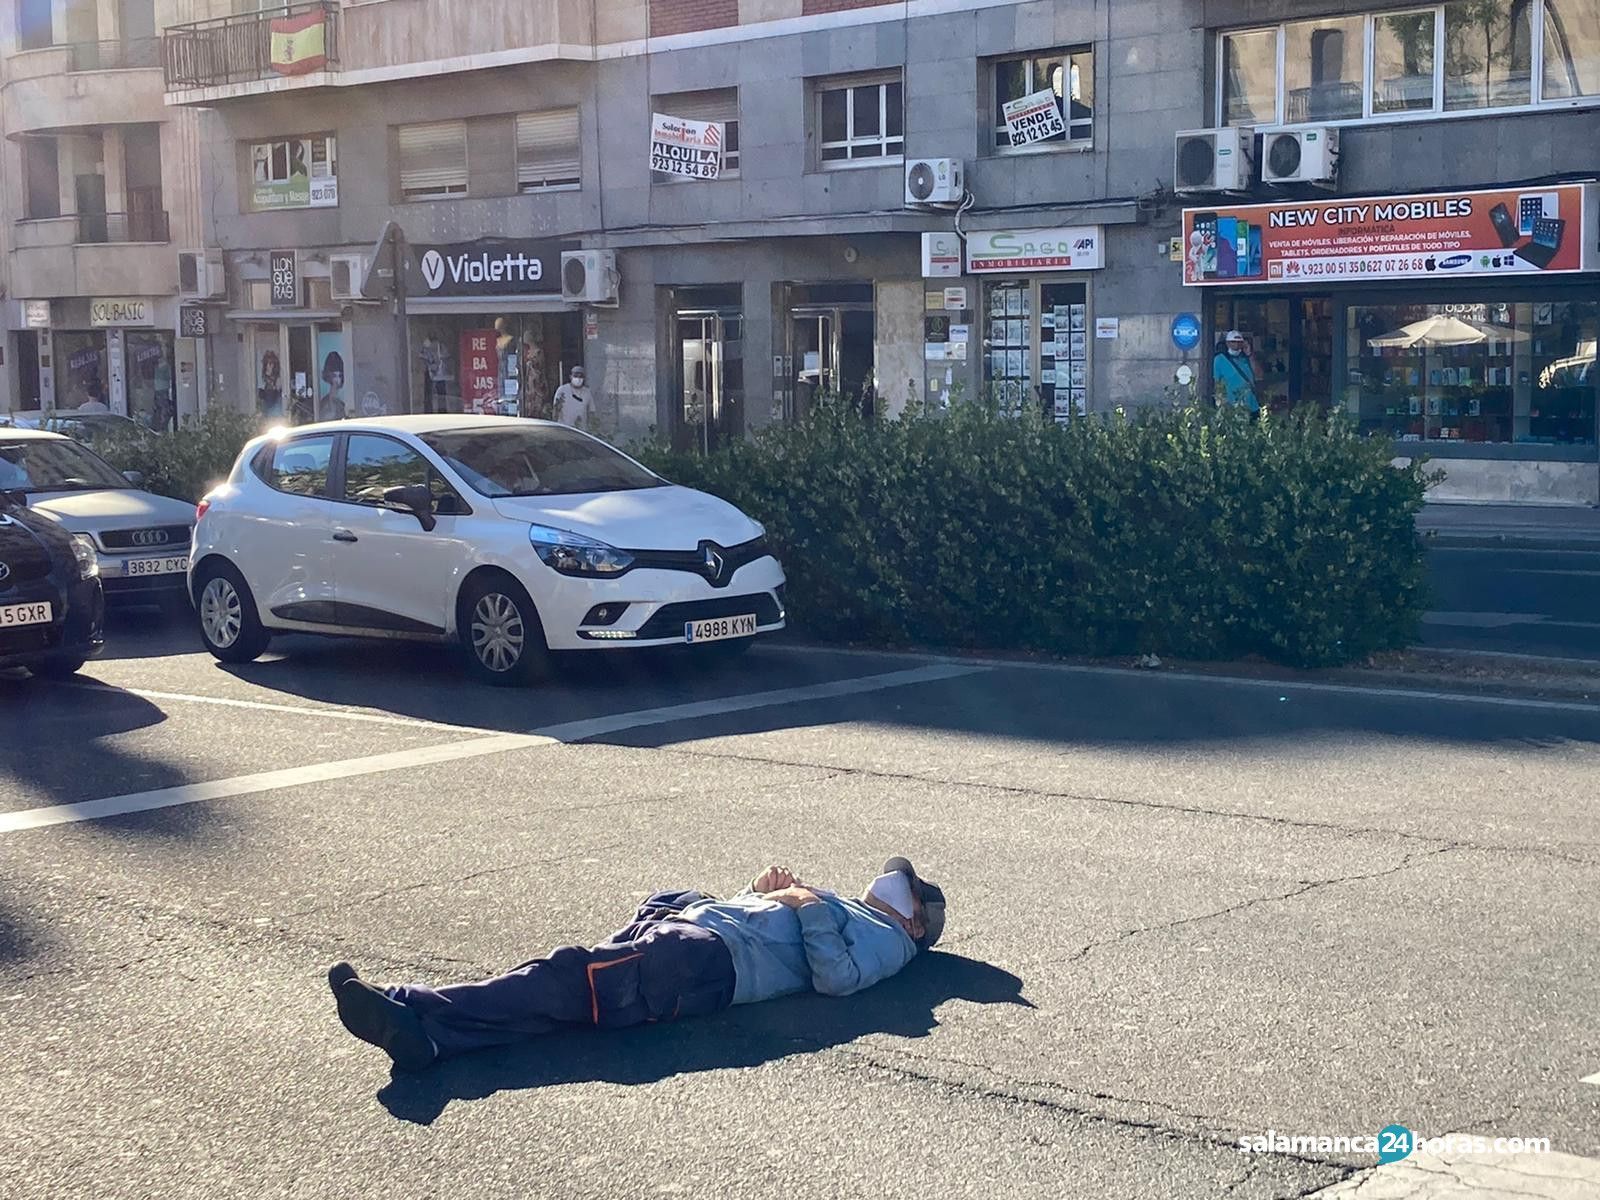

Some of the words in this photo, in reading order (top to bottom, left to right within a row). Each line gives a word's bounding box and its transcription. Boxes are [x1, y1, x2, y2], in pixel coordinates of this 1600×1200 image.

[1011, 108, 1053, 131] VENDE
[1011, 130, 1027, 147] 923
[1026, 127, 1039, 142] 12
[1037, 123, 1050, 137] 13
[1050, 119, 1063, 133] 45
[652, 143, 717, 165] ALQUILA
[652, 157, 670, 171] 923
[671, 160, 682, 174] 12
[685, 163, 699, 175] 54
[702, 165, 717, 178] 89
[311, 189, 322, 200] 923
[1269, 209, 1318, 228] NEW
[1323, 205, 1369, 225] CITY
[1374, 199, 1472, 222] MOBILES
[972, 232, 1069, 258] SAGO
[1077, 238, 1094, 250] API
[1268, 240, 1291, 249] VENTA
[1291, 239, 1301, 247] DE
[1332, 234, 1374, 245] LIBERACIÓN
[1380, 231, 1427, 242] REPARACIÓN
[1427, 232, 1438, 240] DE
[1310, 245, 1363, 256] ORDENADORES
[1369, 241, 1410, 252] PORTÁTILES
[1410, 243, 1422, 251] DE
[1422, 241, 1443, 250] TODO
[1443, 241, 1461, 249] TIPO
[446, 252, 543, 284] Violetta
[972, 257, 1069, 269] INMOBILIARIA
[1307, 263, 1324, 275] 923
[1325, 262, 1337, 274] 00
[1338, 261, 1347, 273] 51
[1349, 260, 1359, 273] 35
[1366, 260, 1382, 273] 627
[1384, 259, 1396, 271] 07
[1398, 259, 1409, 271] 26
[1411, 258, 1424, 271] 68
[471, 337, 487, 350] RE
[472, 357, 488, 370] BA
[472, 376, 494, 389] JAS
[130, 560, 161, 575] 3832
[165, 558, 188, 571] CYC
[17, 604, 46, 622] GXR
[695, 620, 728, 639] 4988
[731, 616, 754, 635] KYN
